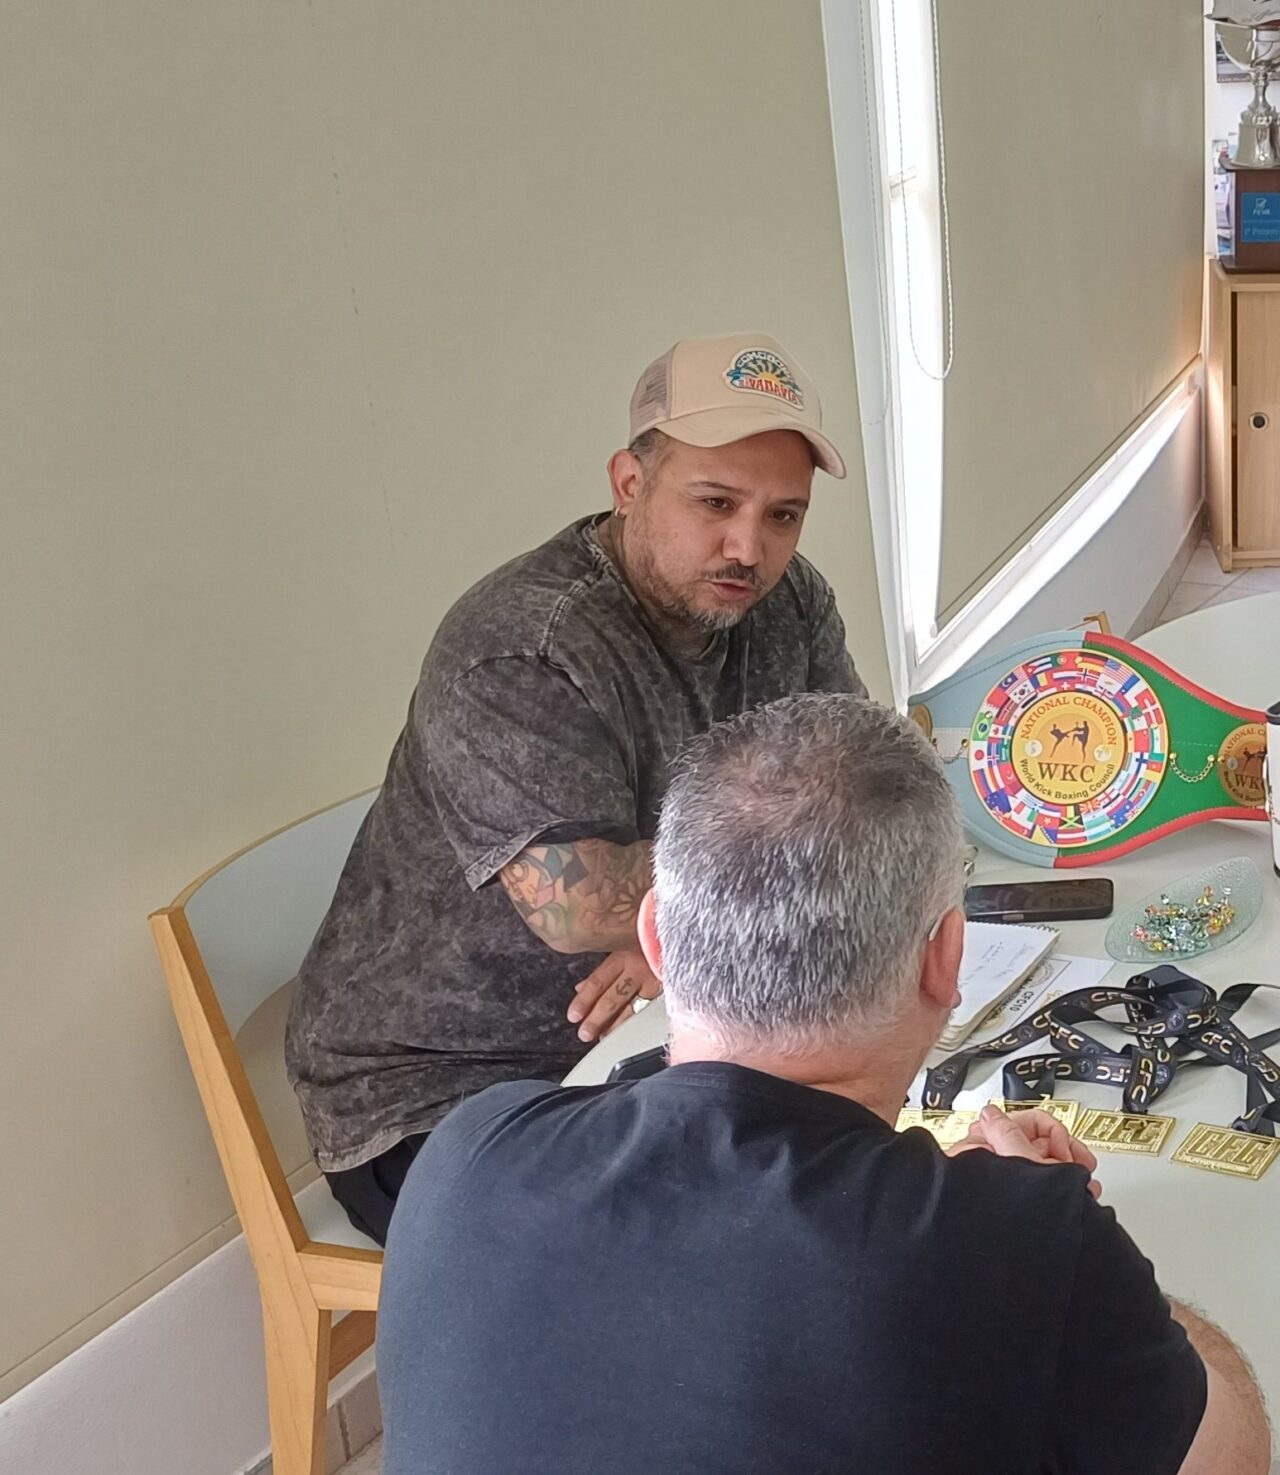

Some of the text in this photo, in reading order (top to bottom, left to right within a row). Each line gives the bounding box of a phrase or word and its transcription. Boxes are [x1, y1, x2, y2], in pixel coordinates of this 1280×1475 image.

[1020, 696, 1117, 746] NATIONAL CHAMPION
[1020, 758, 1115, 800] World Kick Boxing Council
[1037, 762, 1096, 783] WKC
[1201, 1031, 1233, 1054] CFC
[1131, 1057, 1154, 1104] CFC
[1195, 1130, 1269, 1166] CFC
